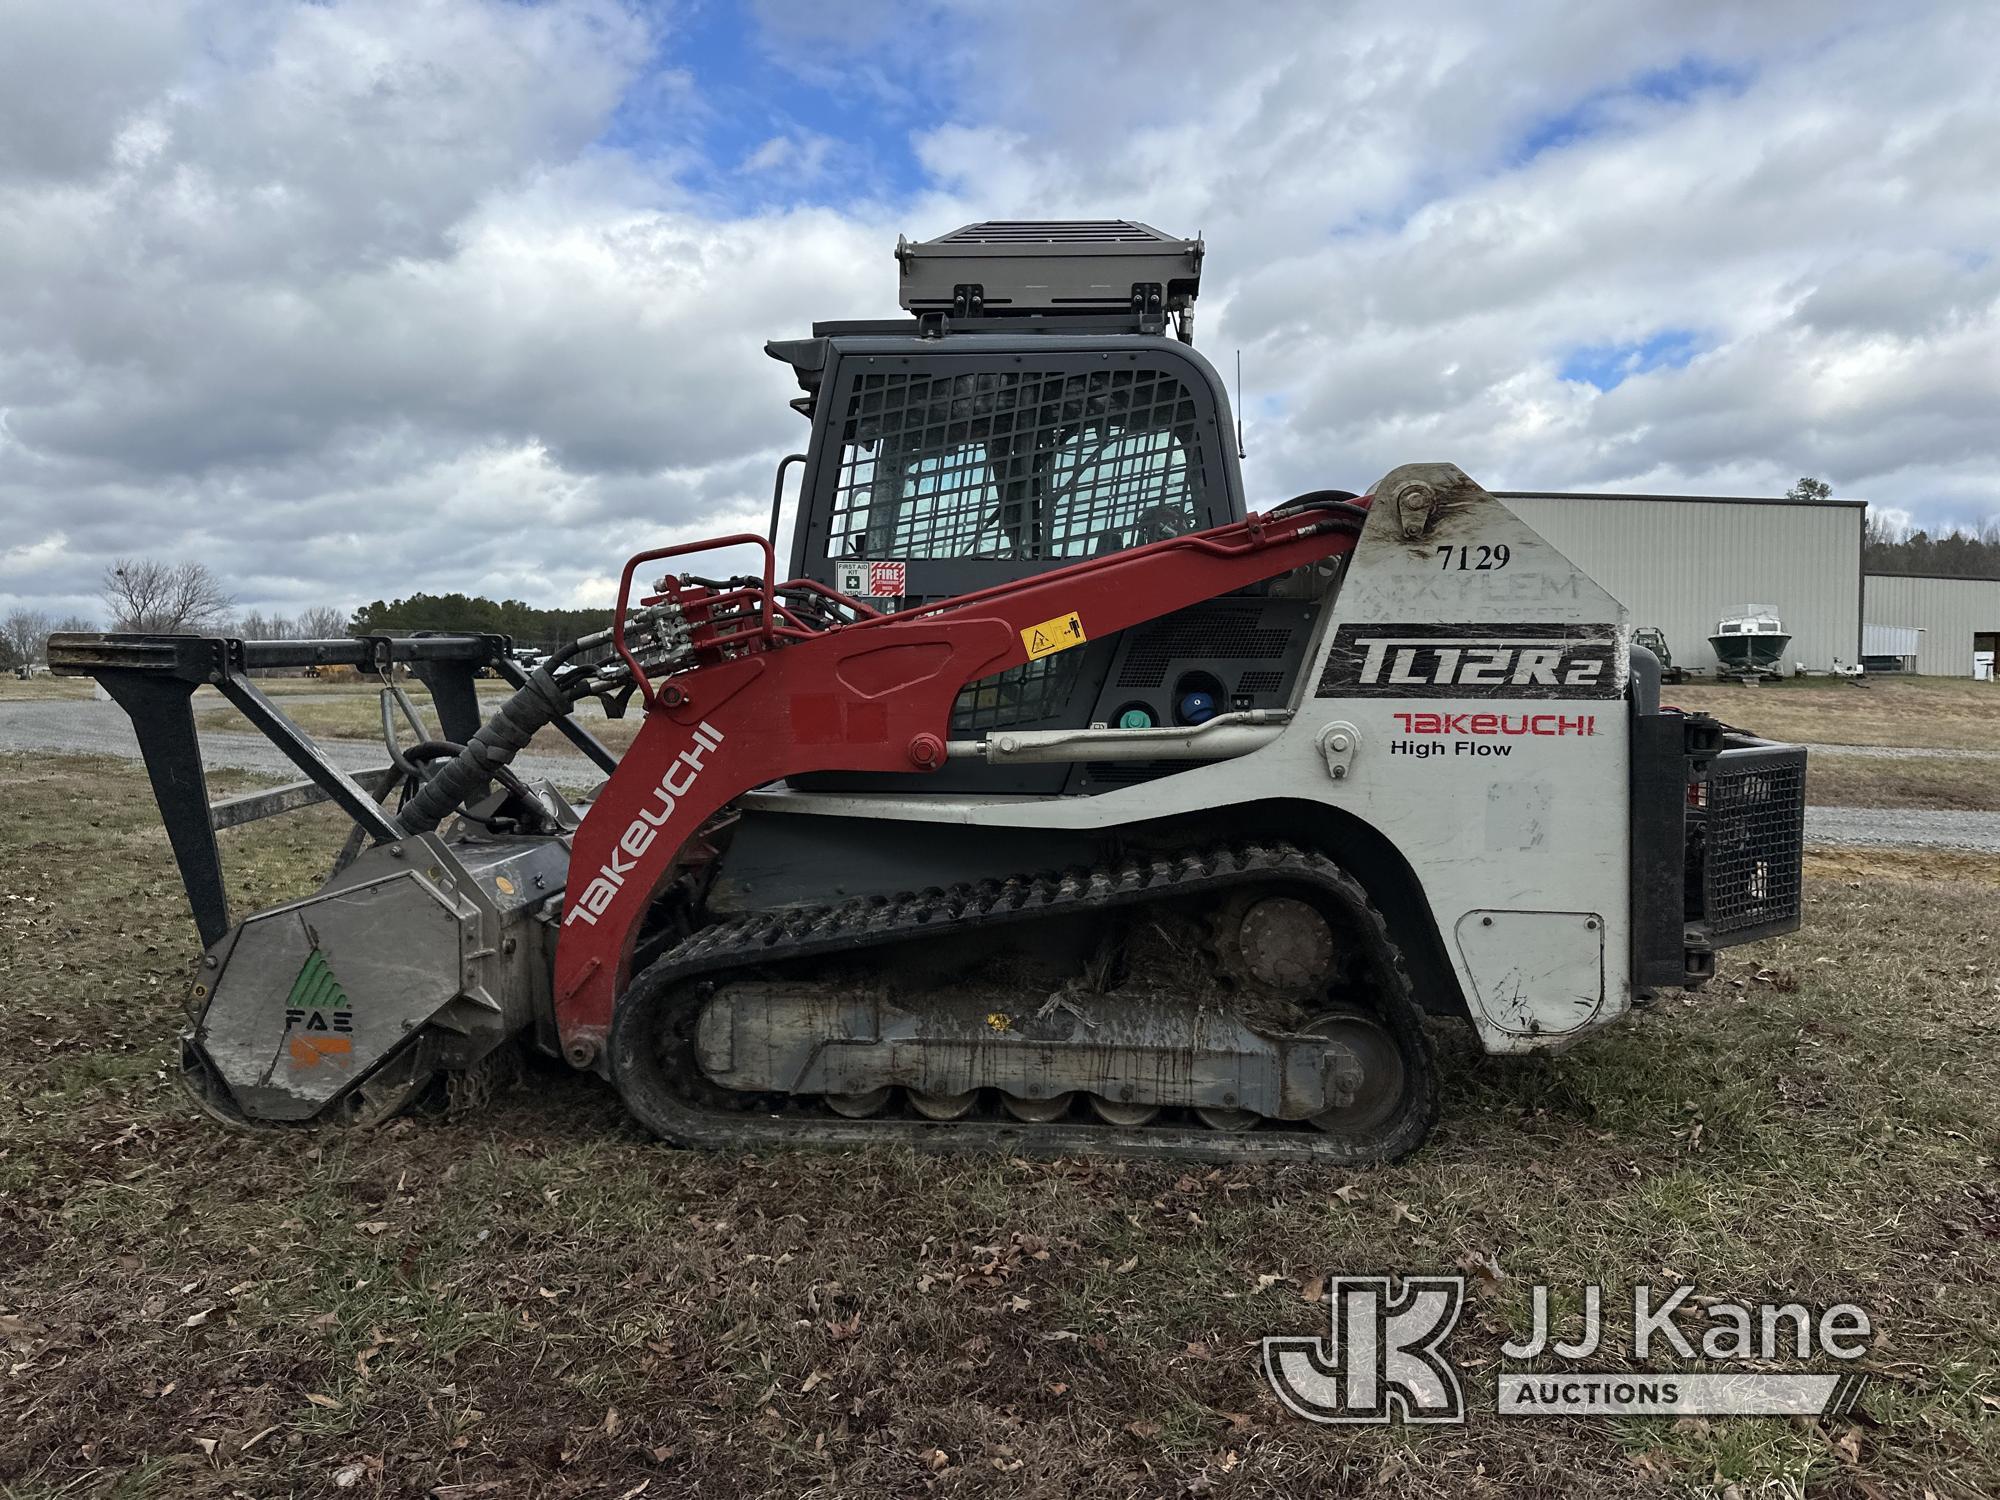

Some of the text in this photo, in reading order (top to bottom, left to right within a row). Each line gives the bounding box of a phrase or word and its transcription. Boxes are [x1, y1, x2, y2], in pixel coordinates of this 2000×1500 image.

[1436, 544, 1511, 571] 7129
[876, 568, 899, 580] FIRE
[1390, 740, 1512, 759] High Flow
[285, 1009, 353, 1032] FAE
